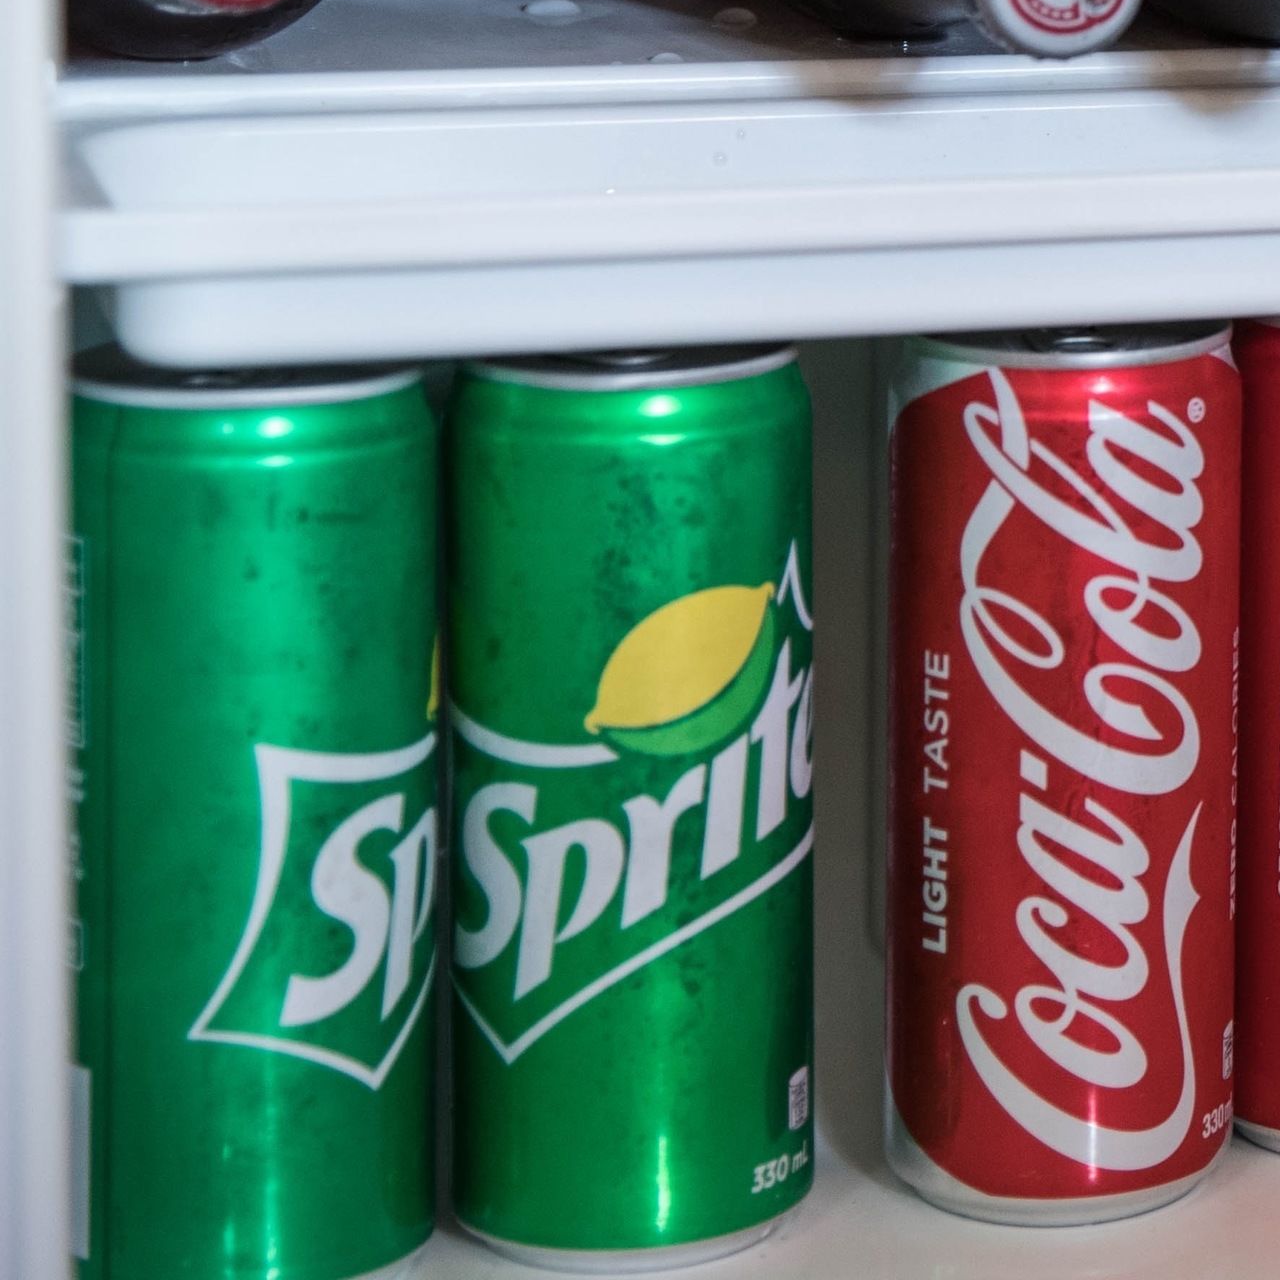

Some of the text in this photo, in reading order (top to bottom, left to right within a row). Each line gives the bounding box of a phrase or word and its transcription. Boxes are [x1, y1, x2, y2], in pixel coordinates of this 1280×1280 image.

[921, 648, 951, 955] LIGHT TASTE
[956, 367, 1205, 1171] Coca-Cola
[751, 1138, 809, 1195] 330 mL
[1202, 1103, 1224, 1139] 330
